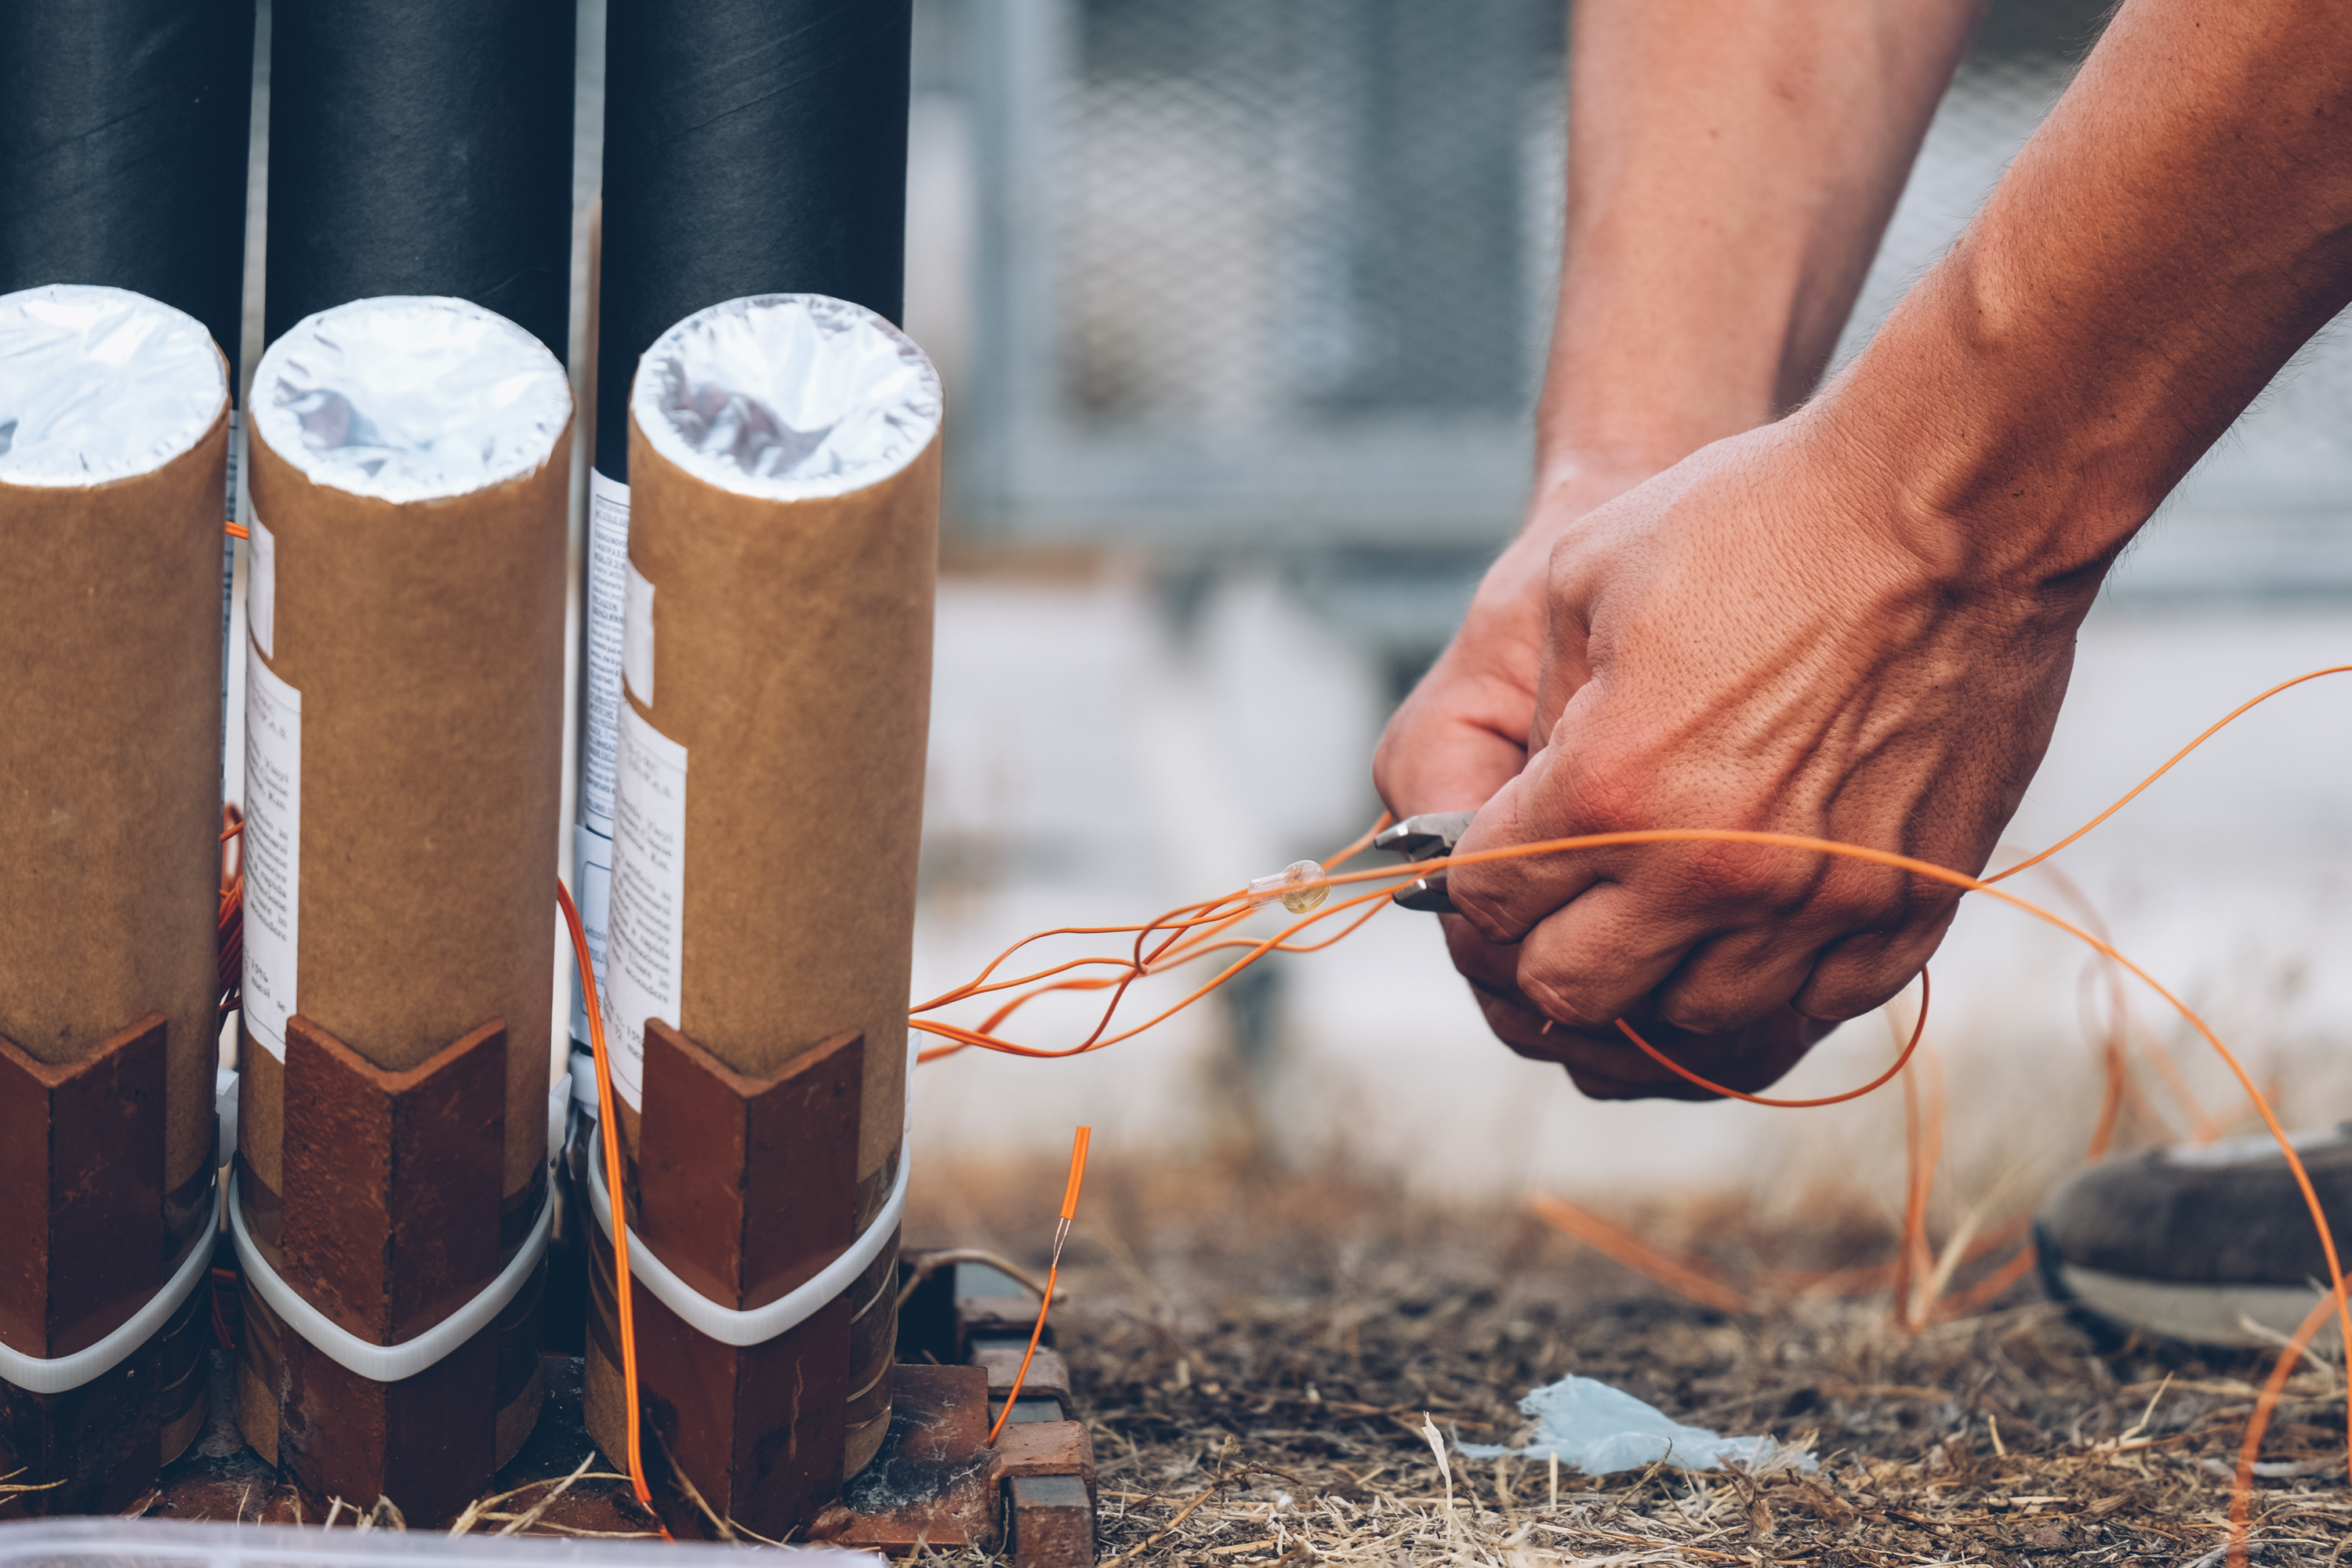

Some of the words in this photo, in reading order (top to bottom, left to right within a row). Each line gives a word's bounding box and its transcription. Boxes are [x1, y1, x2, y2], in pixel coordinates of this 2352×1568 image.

[260, 870, 287, 898] rapida
[640, 934, 670, 960] rapida
[251, 957, 268, 983] 15%
[252, 975, 270, 997] mesi
